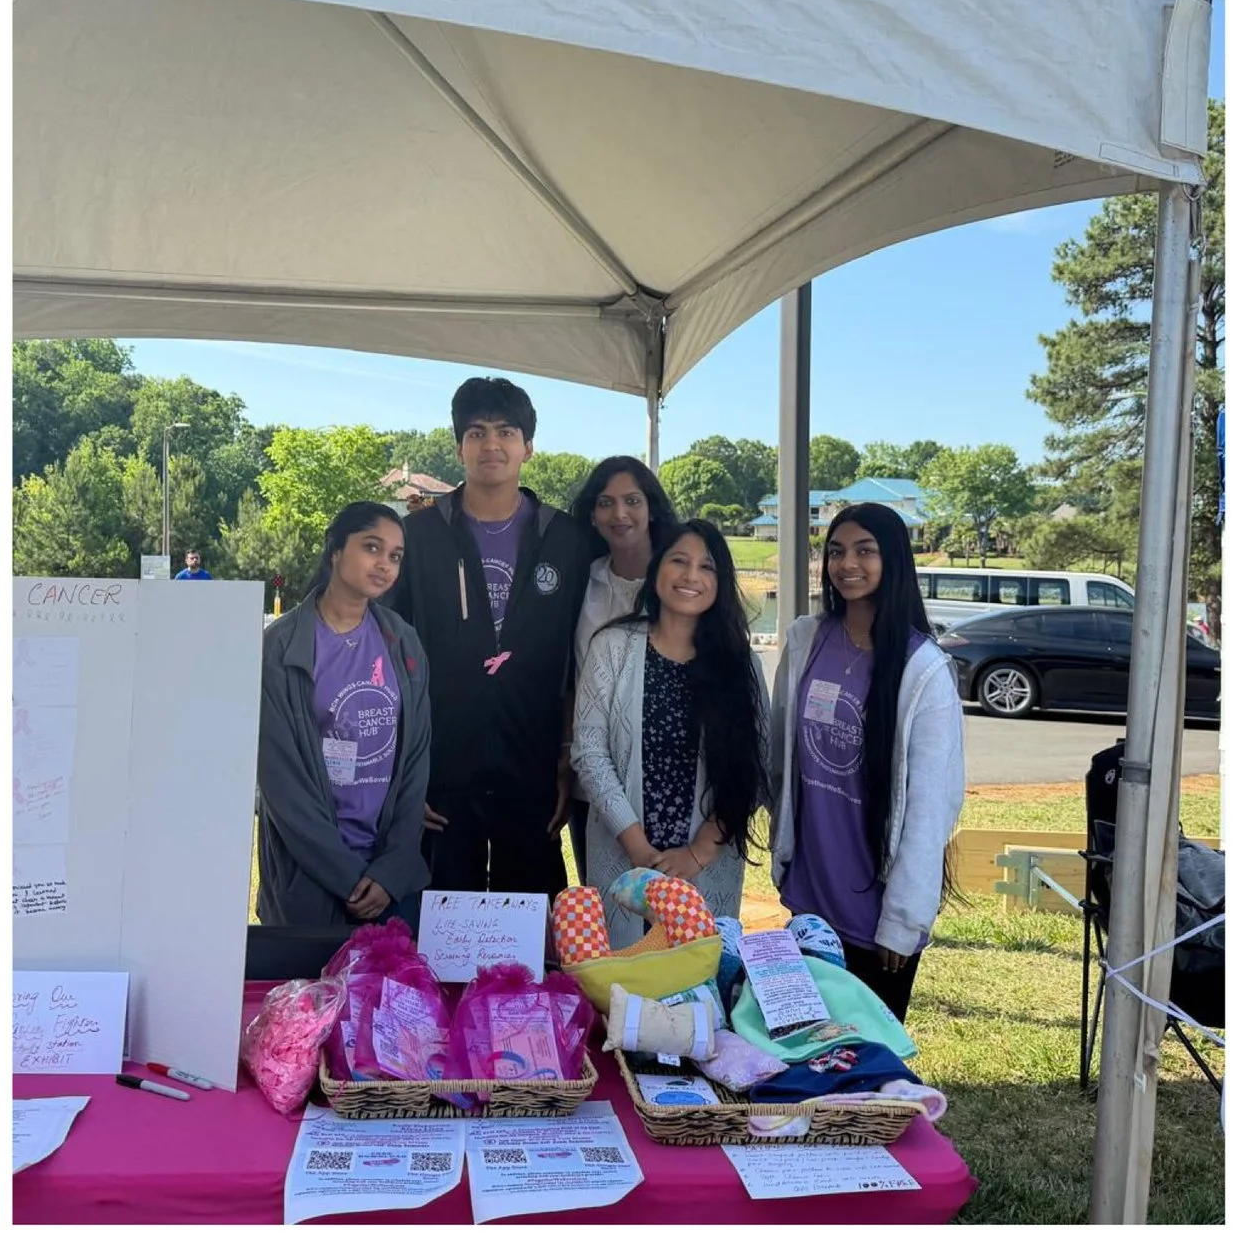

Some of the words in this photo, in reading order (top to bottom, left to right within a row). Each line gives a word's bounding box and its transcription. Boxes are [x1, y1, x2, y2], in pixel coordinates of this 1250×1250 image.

[27, 582, 122, 605] CANCER
[358, 707, 394, 718] BREAST
[358, 717, 397, 729] CANCER
[359, 727, 378, 738] HUB
[431, 895, 462, 911] FREE
[478, 933, 518, 944] Detection
[51, 985, 75, 1002] Our
[20, 1054, 74, 1067] EXHIBIT
